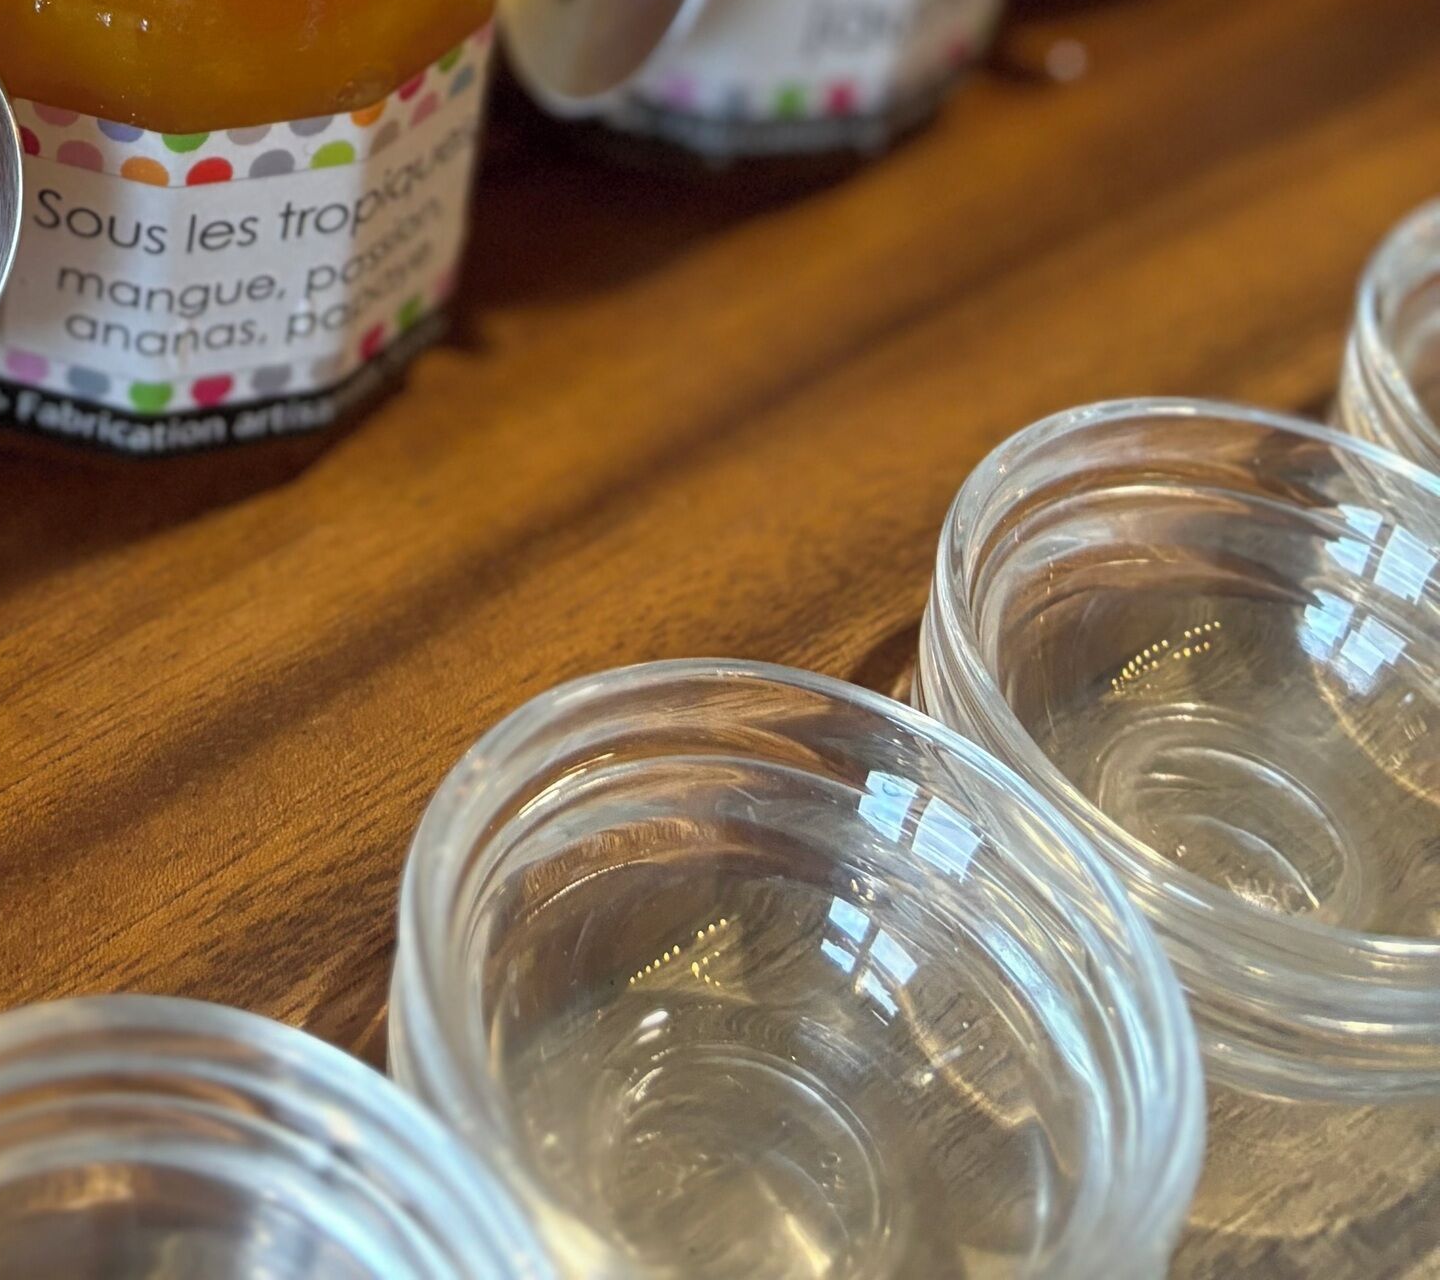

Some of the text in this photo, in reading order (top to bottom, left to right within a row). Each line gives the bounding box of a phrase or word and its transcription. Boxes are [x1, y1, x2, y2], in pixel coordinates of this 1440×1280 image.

[32, 187, 168, 256] Sous
[185, 212, 260, 254] les
[56, 263, 287, 319] mangue,
[63, 306, 268, 359] ananas,
[14, 390, 228, 451] Fabrication
